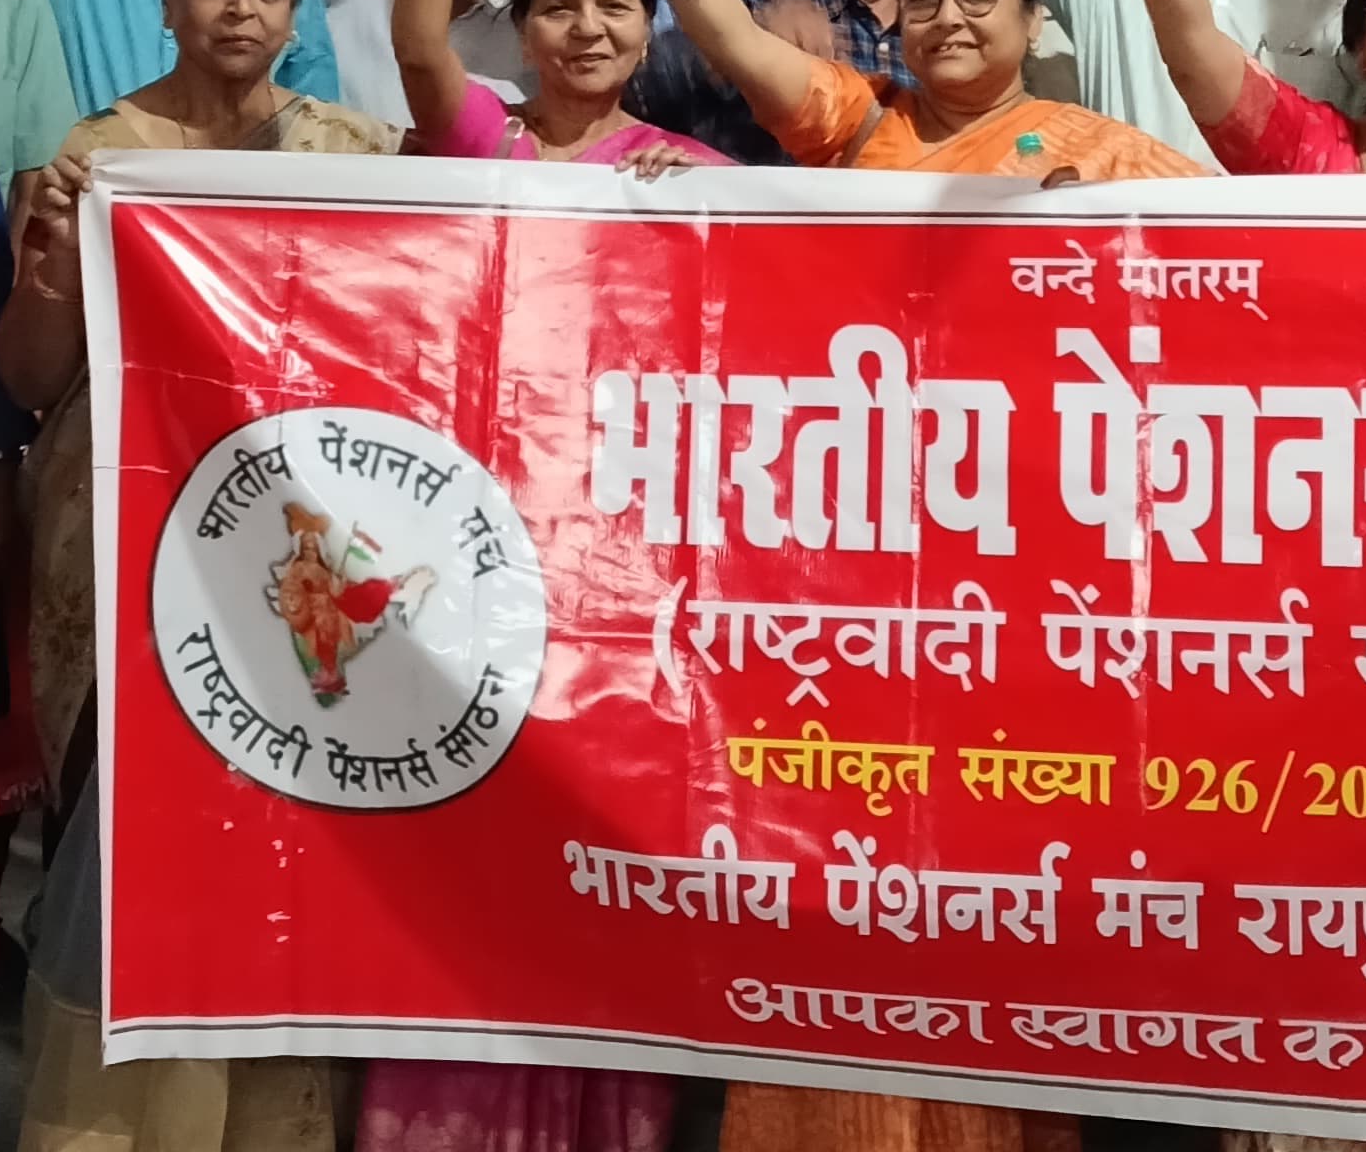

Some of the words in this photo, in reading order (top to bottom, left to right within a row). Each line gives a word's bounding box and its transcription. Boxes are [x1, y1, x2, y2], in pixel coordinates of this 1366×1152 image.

[1010, 241, 1098, 304] वन्दे
[1117, 257, 1269, 321] मातरम्
[197, 444, 293, 540] भारतीय
[318, 421, 461, 508] पेंशनर्स
[591, 323, 1017, 556] भारतीय
[652, 576, 1006, 708] (राष्ट्रवादी
[1041, 579, 1314, 700] पेंशनर्स
[176, 623, 313, 779] राष्ट्रवादी
[324, 737, 438, 793] पेंशनर्स
[726, 718, 935, 816] पंजीकृत
[958, 728, 1116, 806] संख्या
[563, 823, 796, 929] भारतीय
[823, 829, 1071, 945] पेंशनर्स
[1091, 849, 1204, 950] मंच
[724, 976, 994, 1044] आपका
[1005, 1001, 1266, 1065] स्वागत
